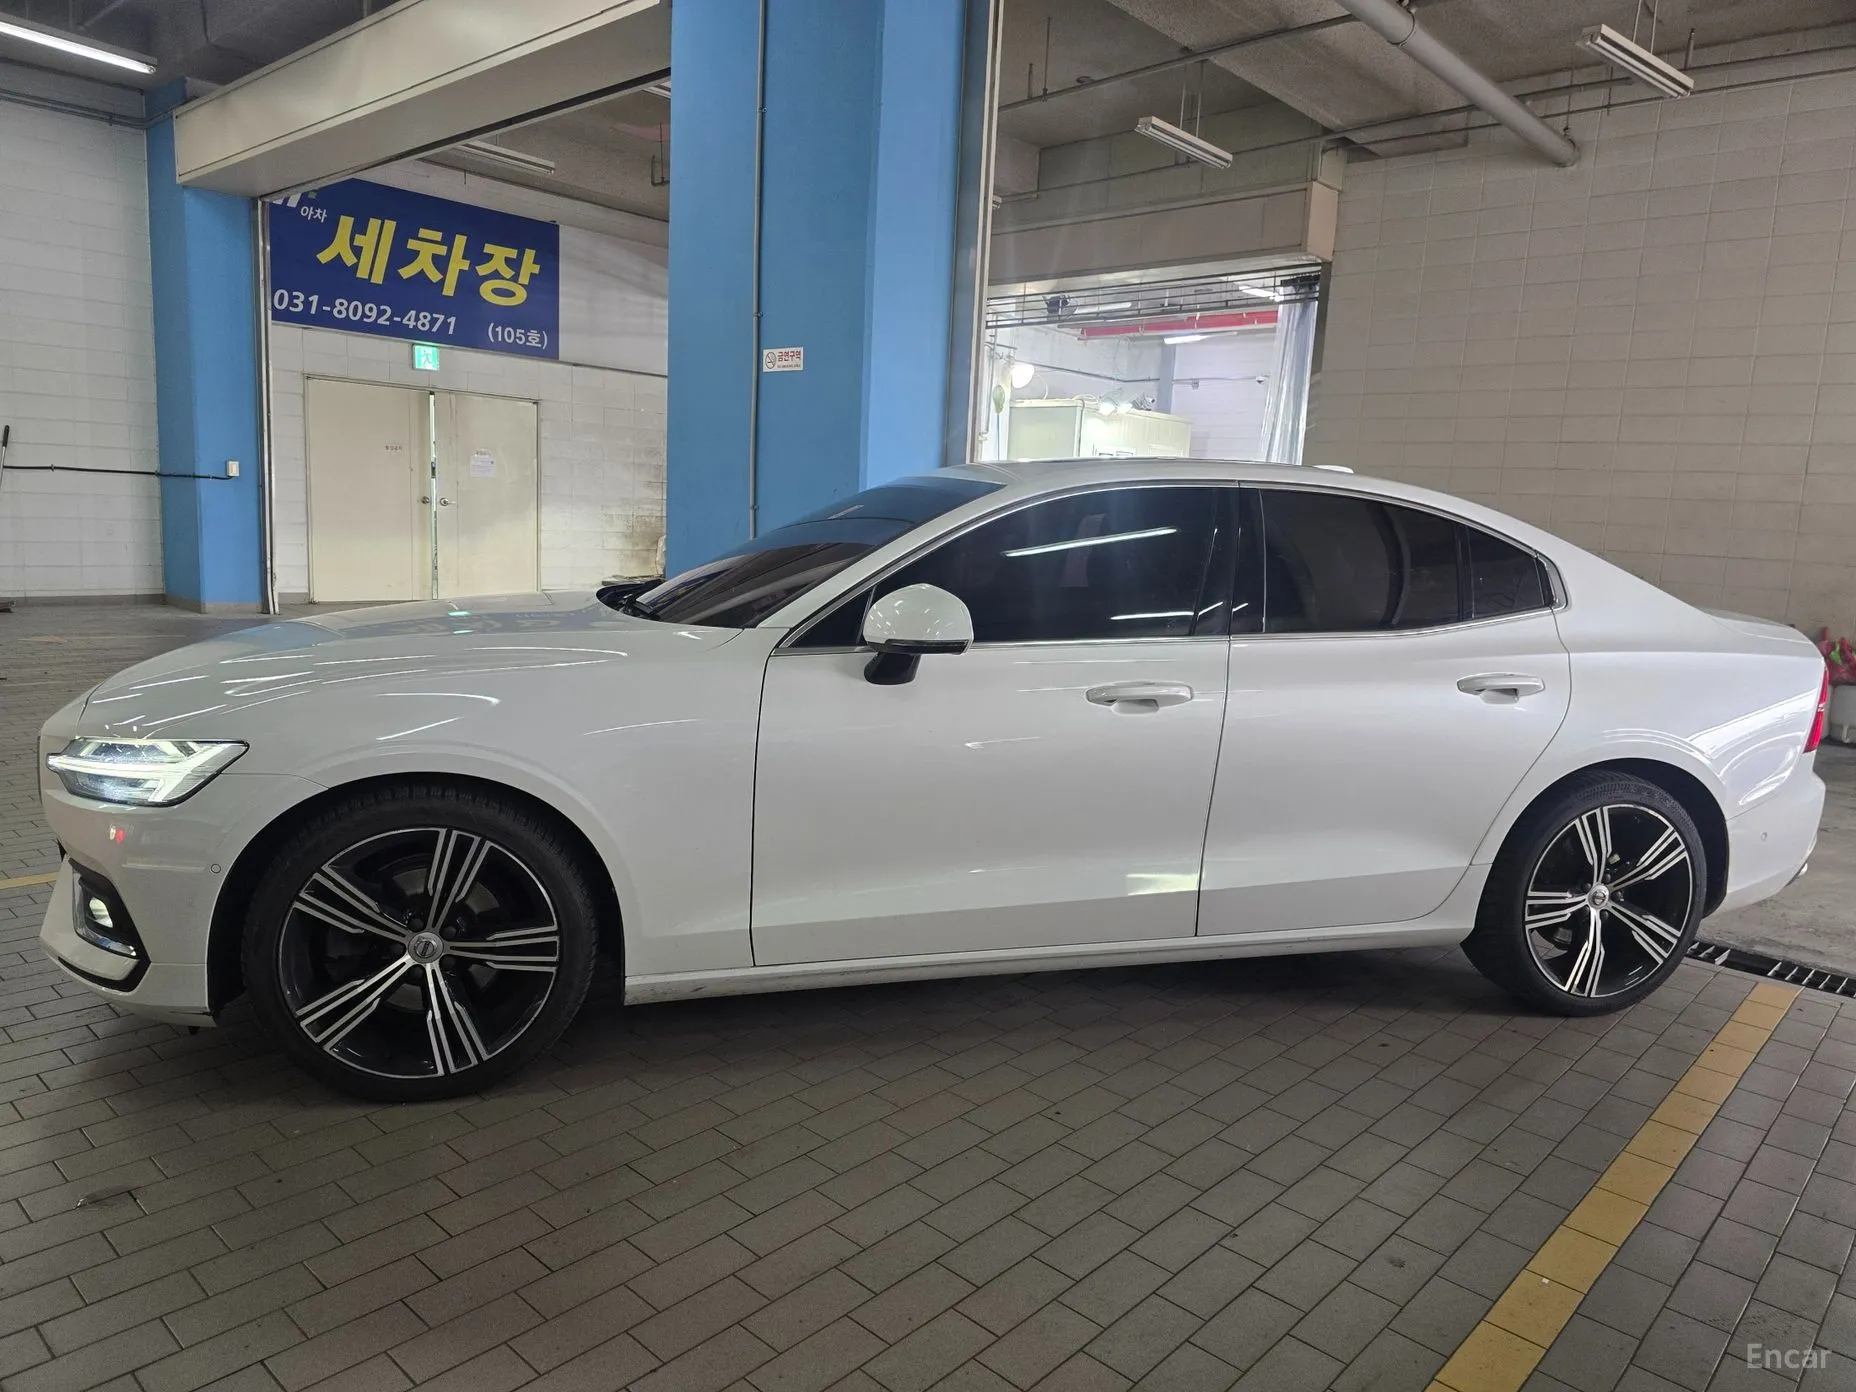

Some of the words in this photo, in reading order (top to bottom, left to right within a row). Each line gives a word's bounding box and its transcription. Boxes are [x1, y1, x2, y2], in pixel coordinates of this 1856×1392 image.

[316, 215, 540, 306] 세차장
[273, 289, 456, 335] 031-8092-4871
[488, 322, 548, 350] (105호)
